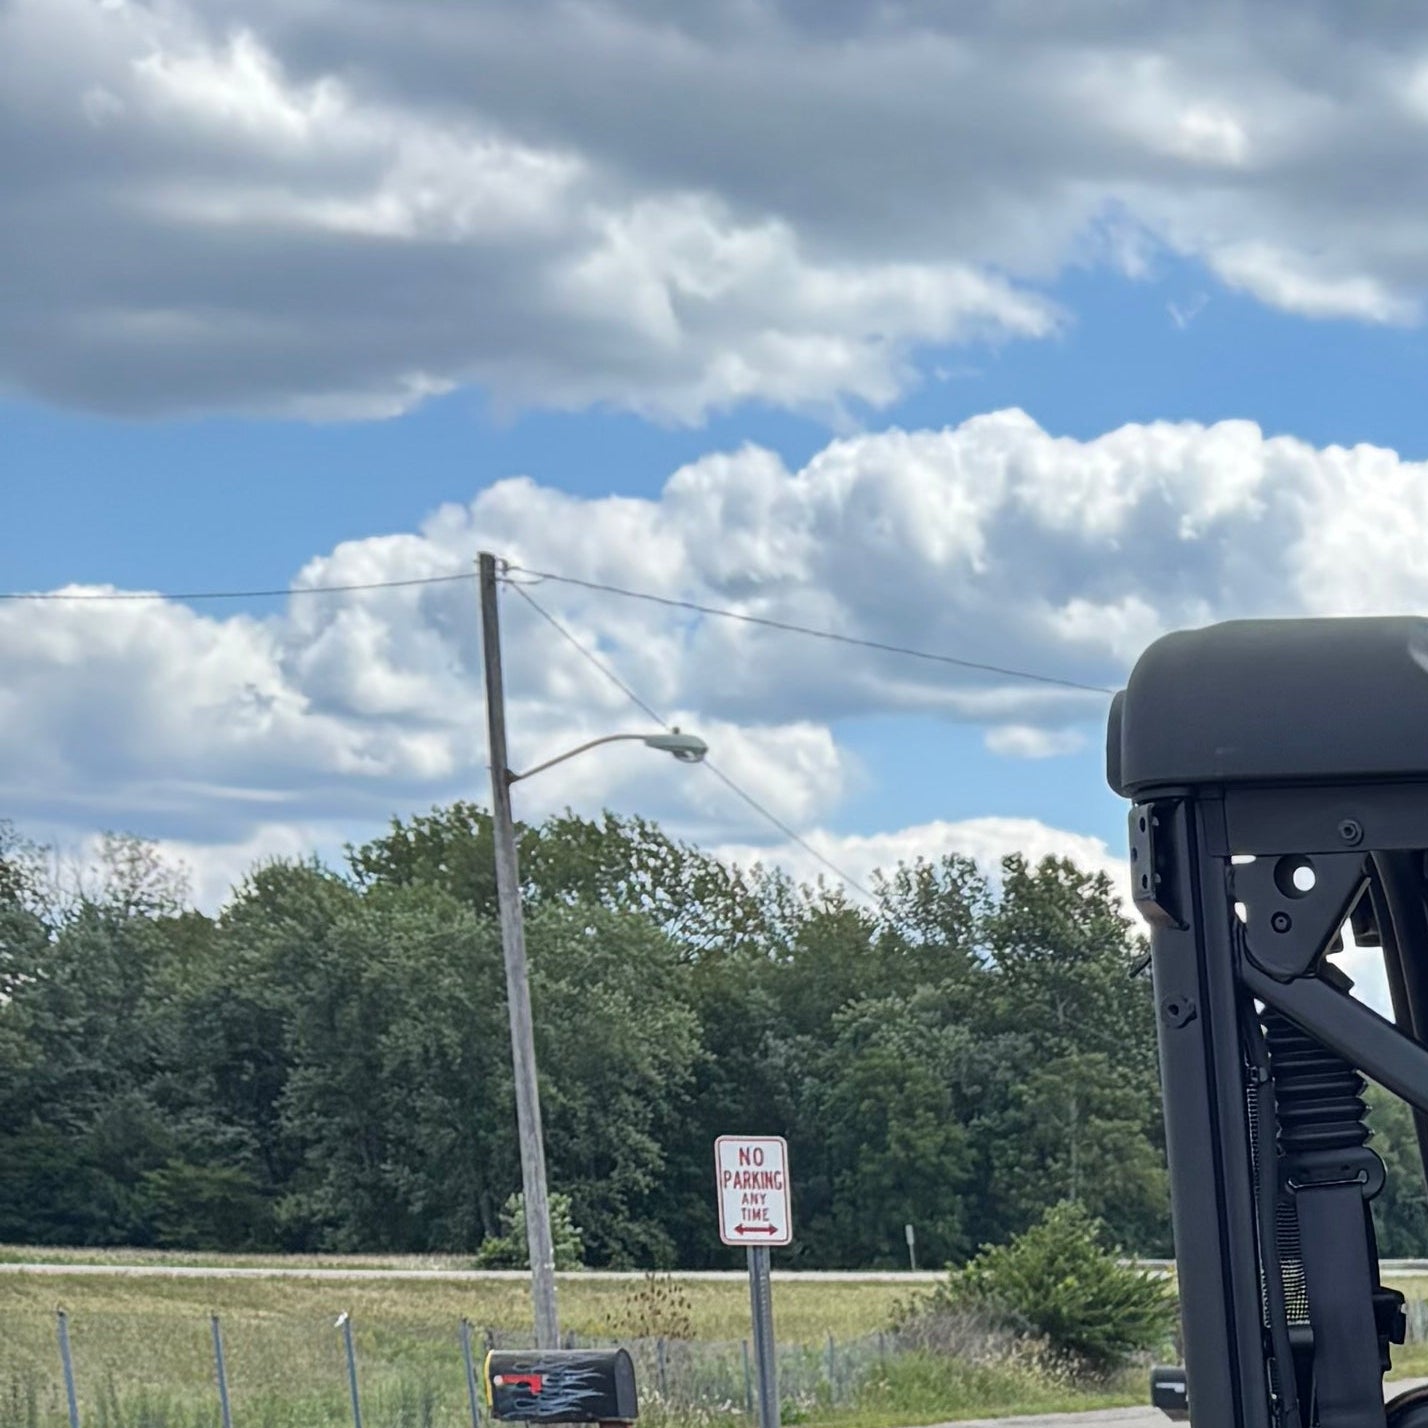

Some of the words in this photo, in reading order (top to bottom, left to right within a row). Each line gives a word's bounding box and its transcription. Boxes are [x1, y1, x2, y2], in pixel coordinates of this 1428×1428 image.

[739, 1147, 764, 1167] NO
[723, 1170, 782, 1190] PARKING
[742, 1193, 767, 1205] ANY
[741, 1207, 769, 1222] TIME
